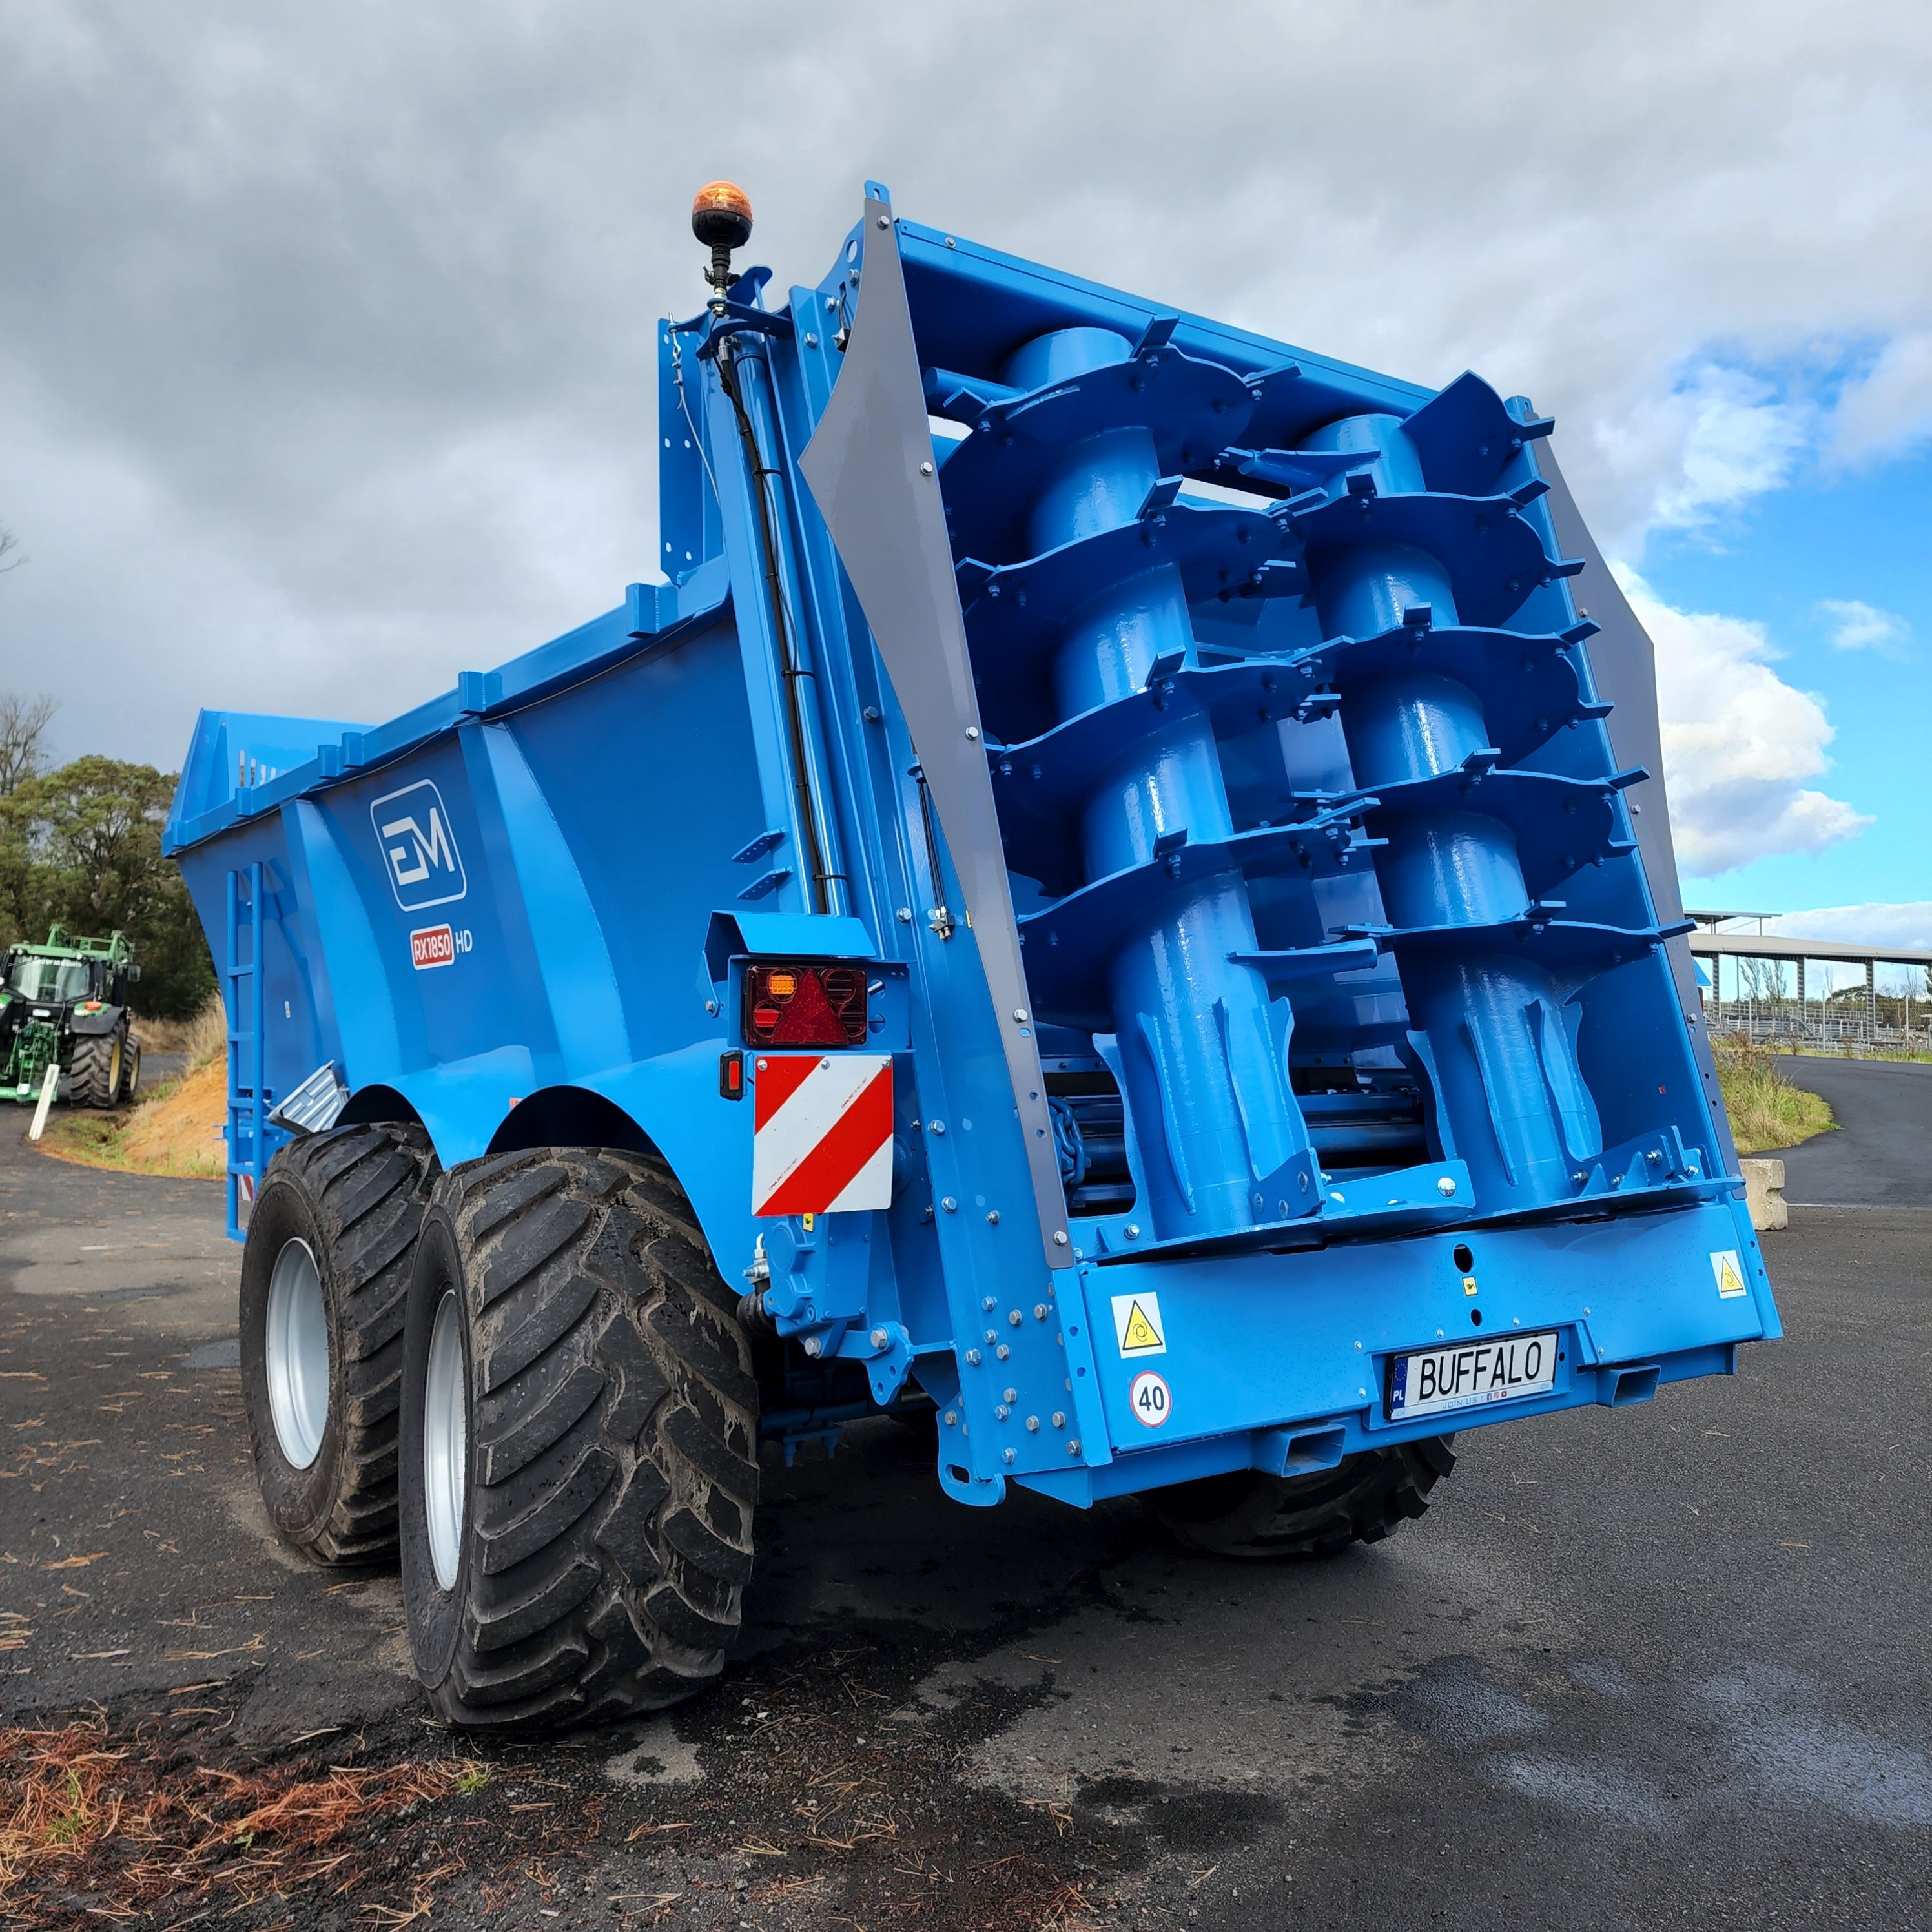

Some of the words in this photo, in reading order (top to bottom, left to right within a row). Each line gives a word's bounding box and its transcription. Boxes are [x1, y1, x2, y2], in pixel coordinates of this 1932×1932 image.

[413, 932, 451, 961] RX1850
[455, 929, 473, 954] HD
[1419, 1341, 1541, 1401] BUFFALO
[1138, 1386, 1165, 1412] 40
[1393, 1390, 1404, 1402] PL
[1443, 1400, 1463, 1410] JOIN
[1465, 1397, 1477, 1406] US
